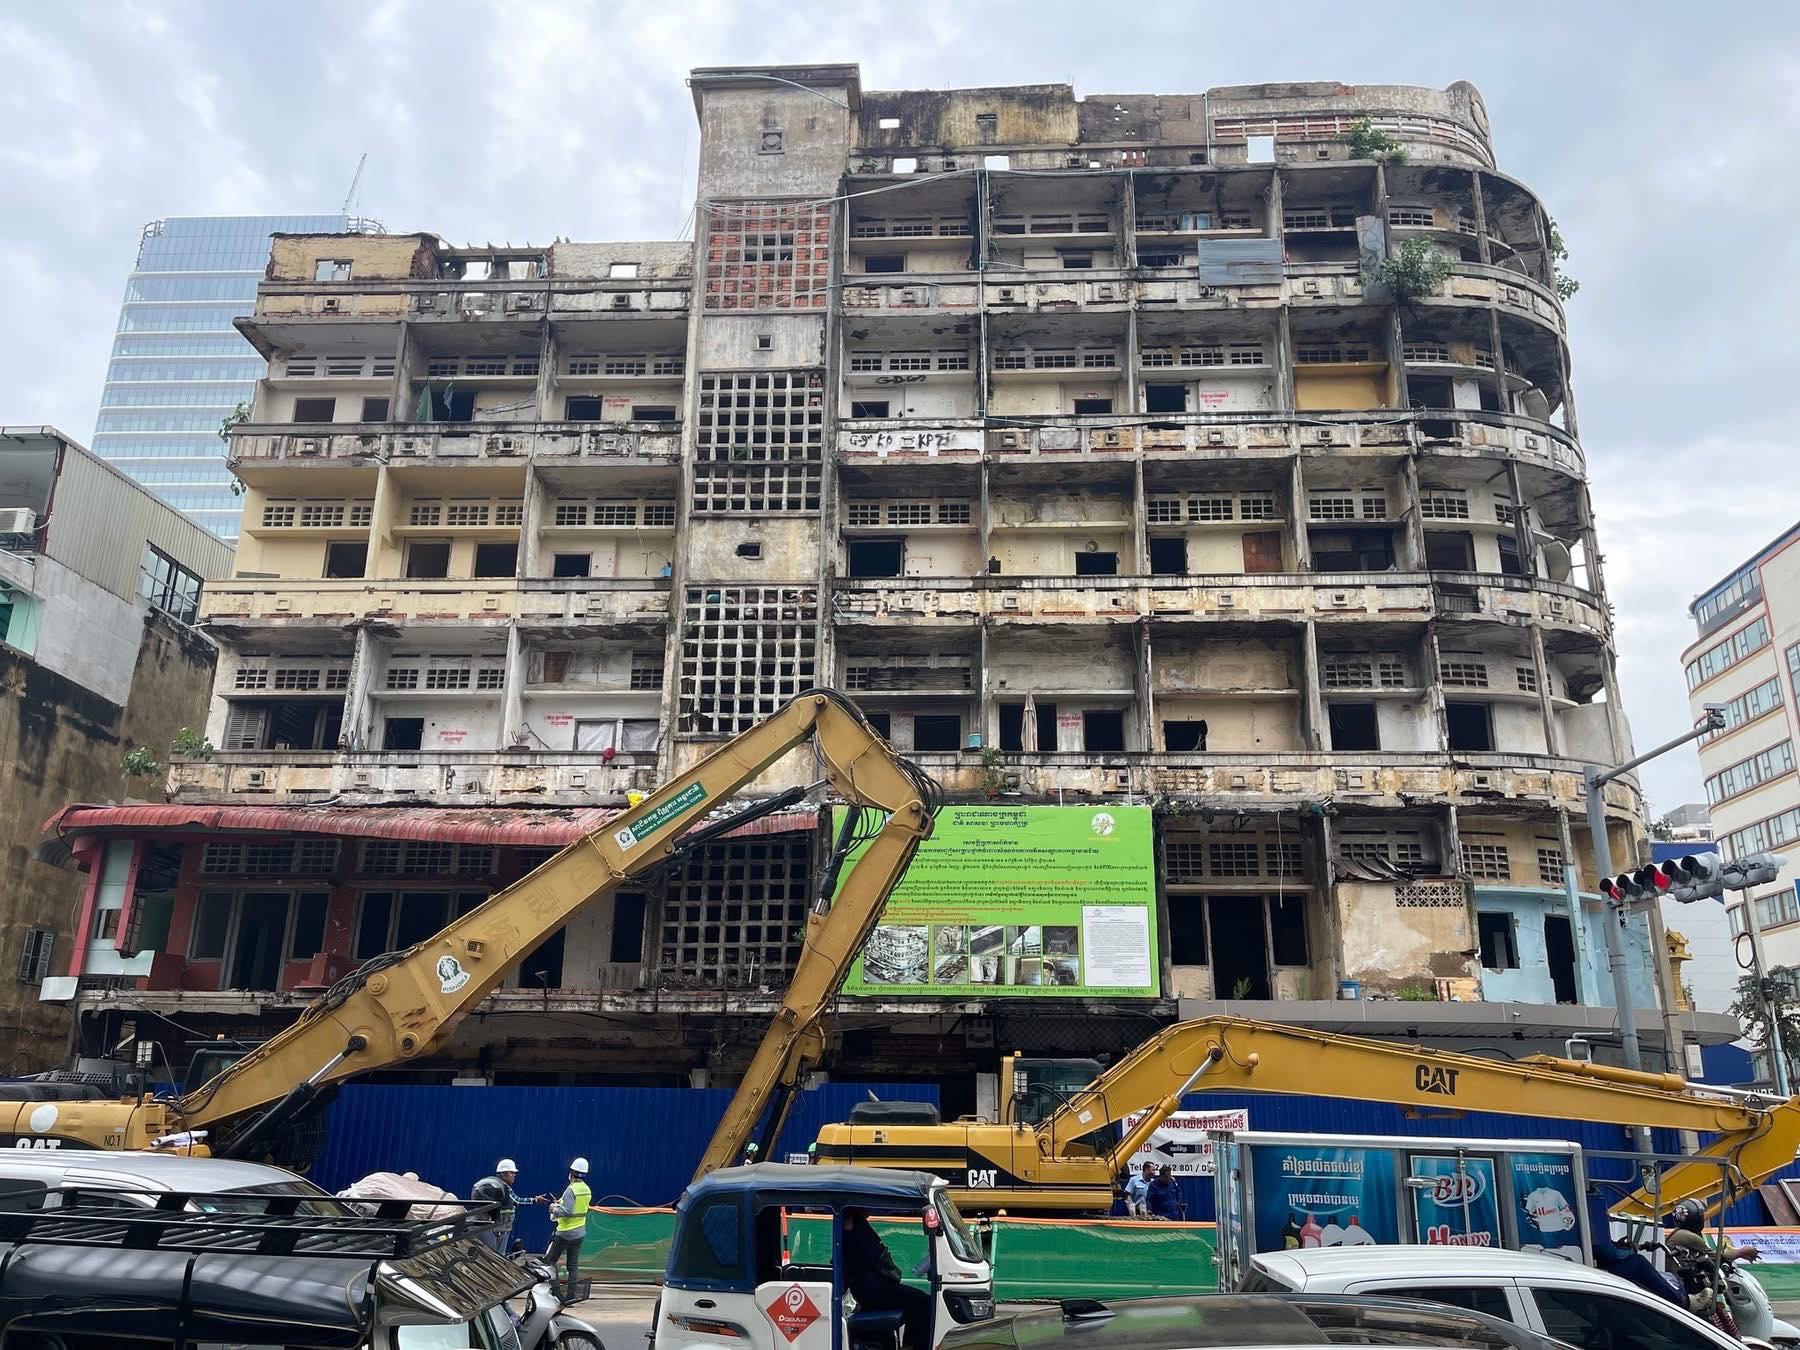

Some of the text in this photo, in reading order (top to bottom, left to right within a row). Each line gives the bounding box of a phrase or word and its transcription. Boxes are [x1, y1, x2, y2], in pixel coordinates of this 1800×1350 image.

[1416, 1064, 1459, 1096] CAT
[16, 1138, 61, 1149] CAT
[968, 1170, 997, 1188] CAT
